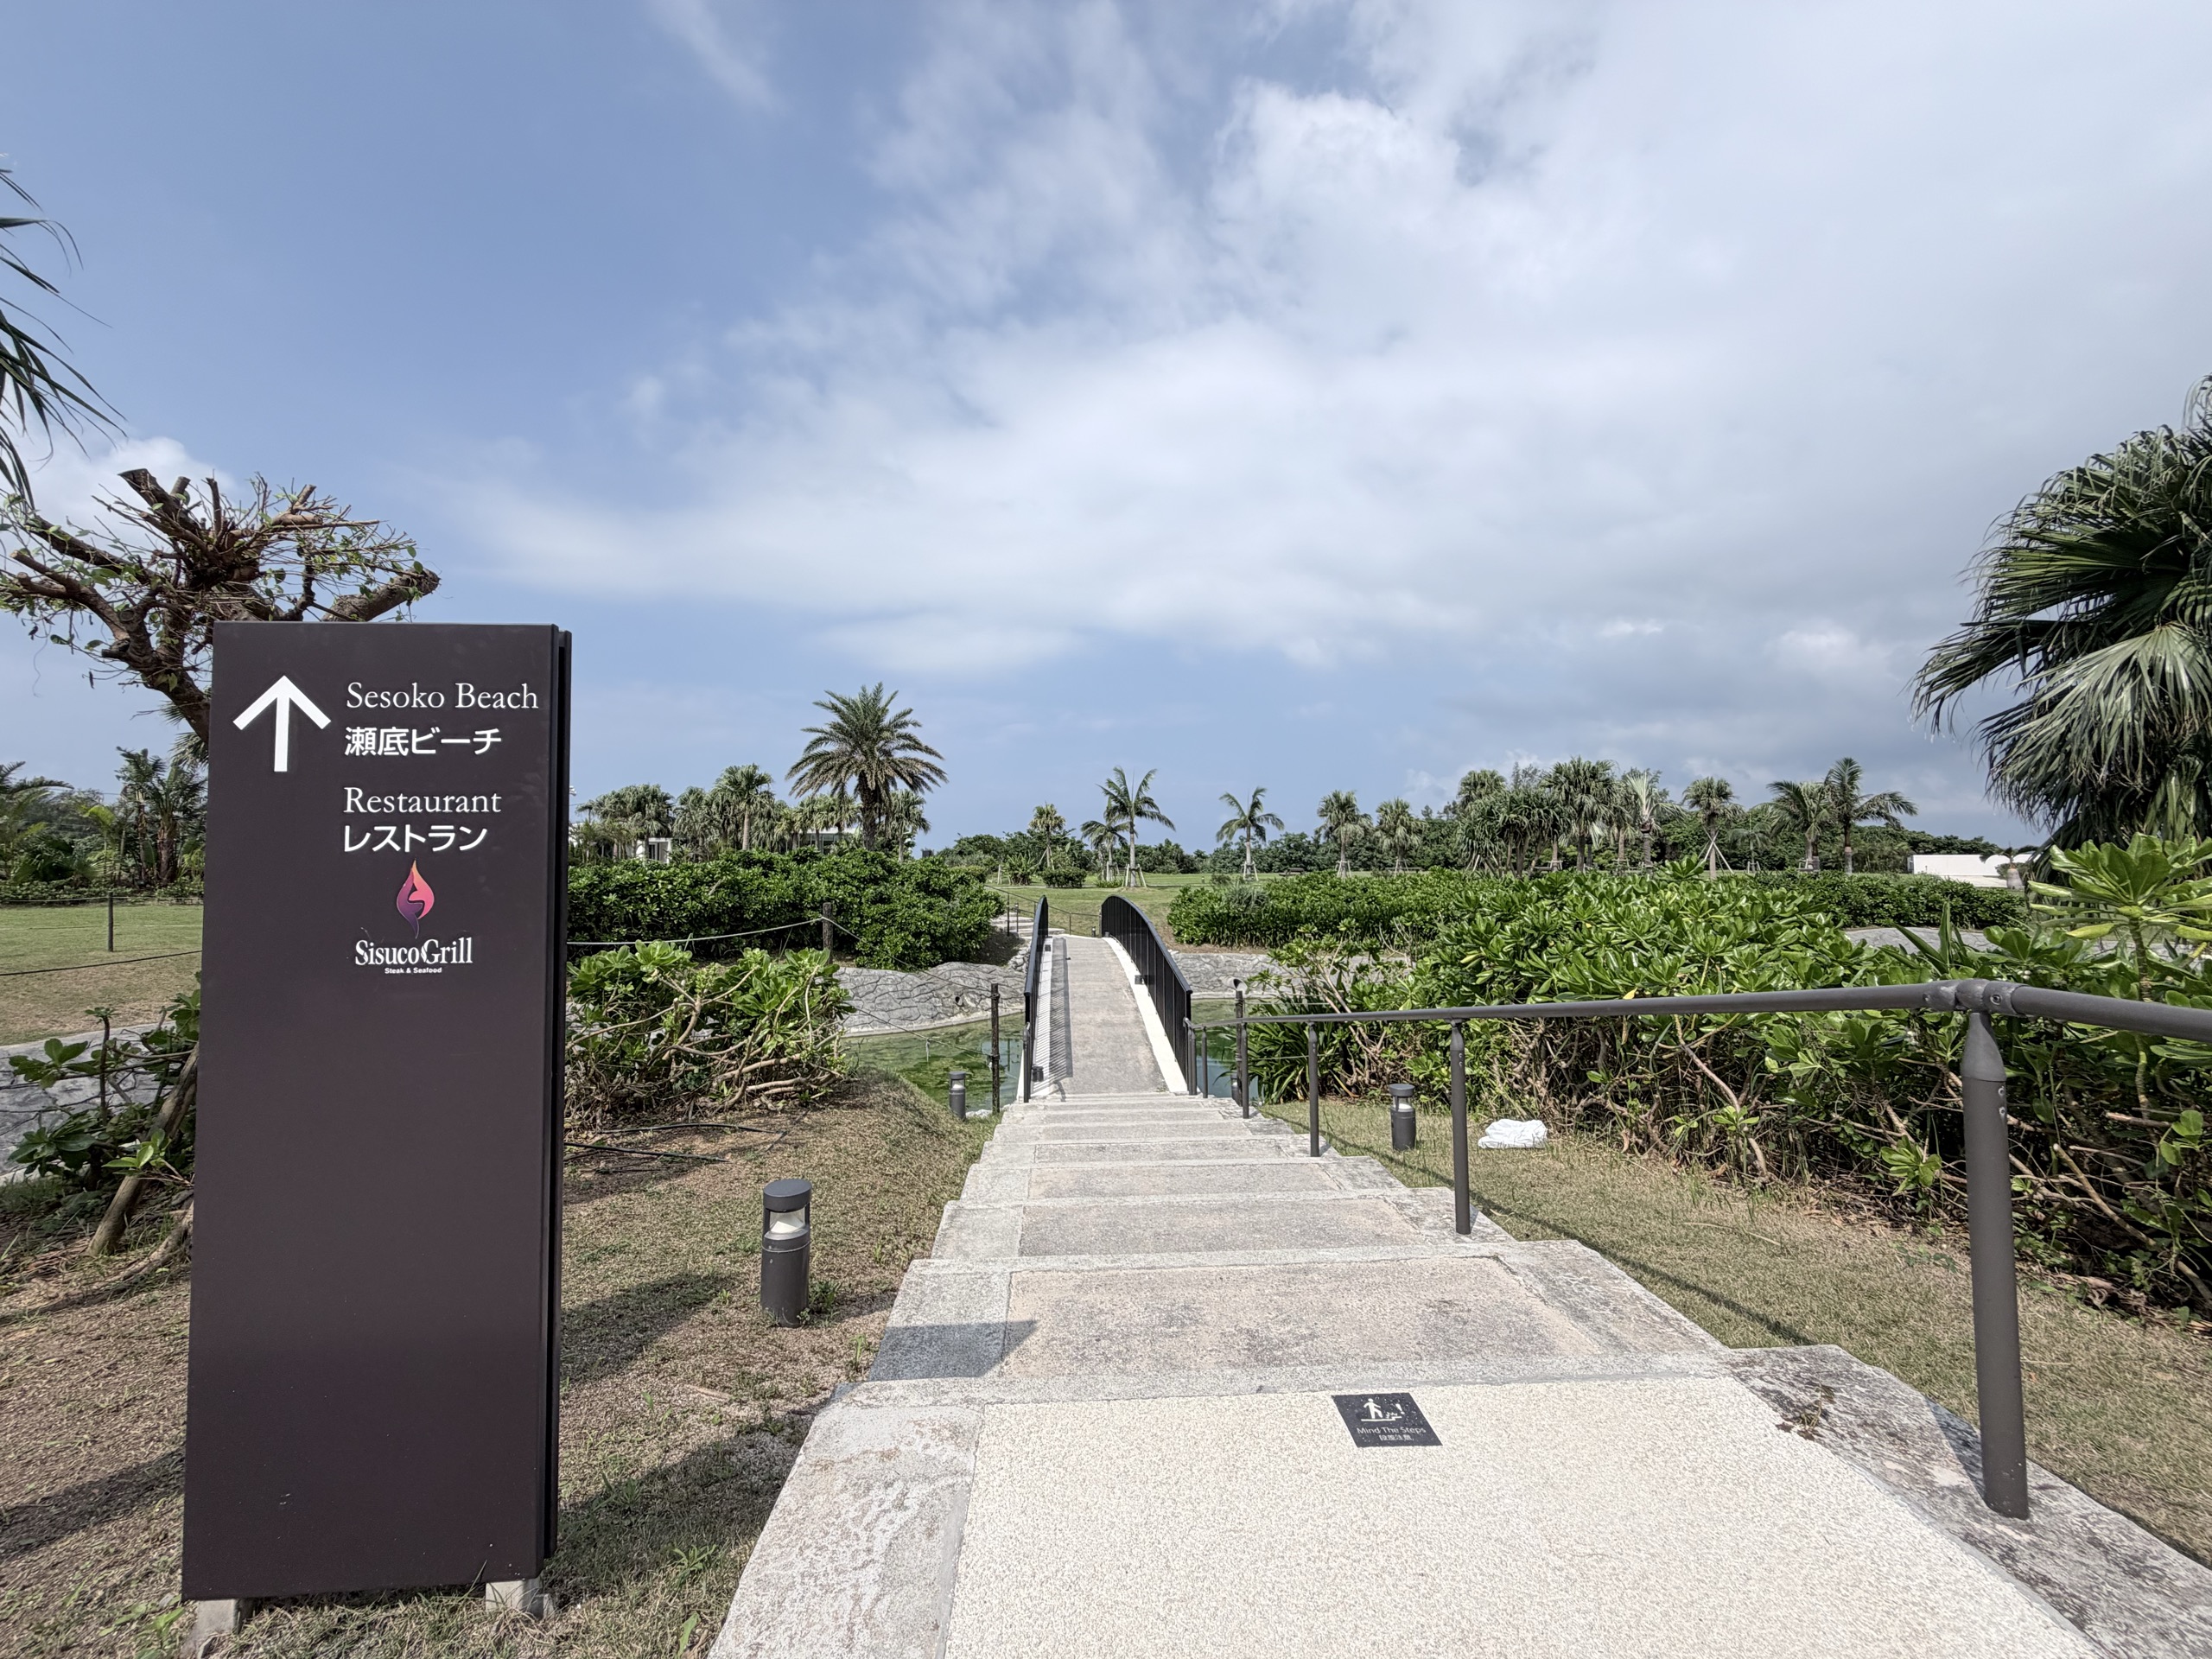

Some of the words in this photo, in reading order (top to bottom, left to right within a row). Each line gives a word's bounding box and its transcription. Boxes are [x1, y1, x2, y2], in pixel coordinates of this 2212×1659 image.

[346, 682, 445, 709] Sesoko
[454, 682, 539, 709] Beach
[344, 726, 502, 757] 瀬底ビーチ
[343, 786, 502, 814] Restaurant
[344, 823, 488, 853] レストラン
[1400, 1427, 1427, 1435] Steps
